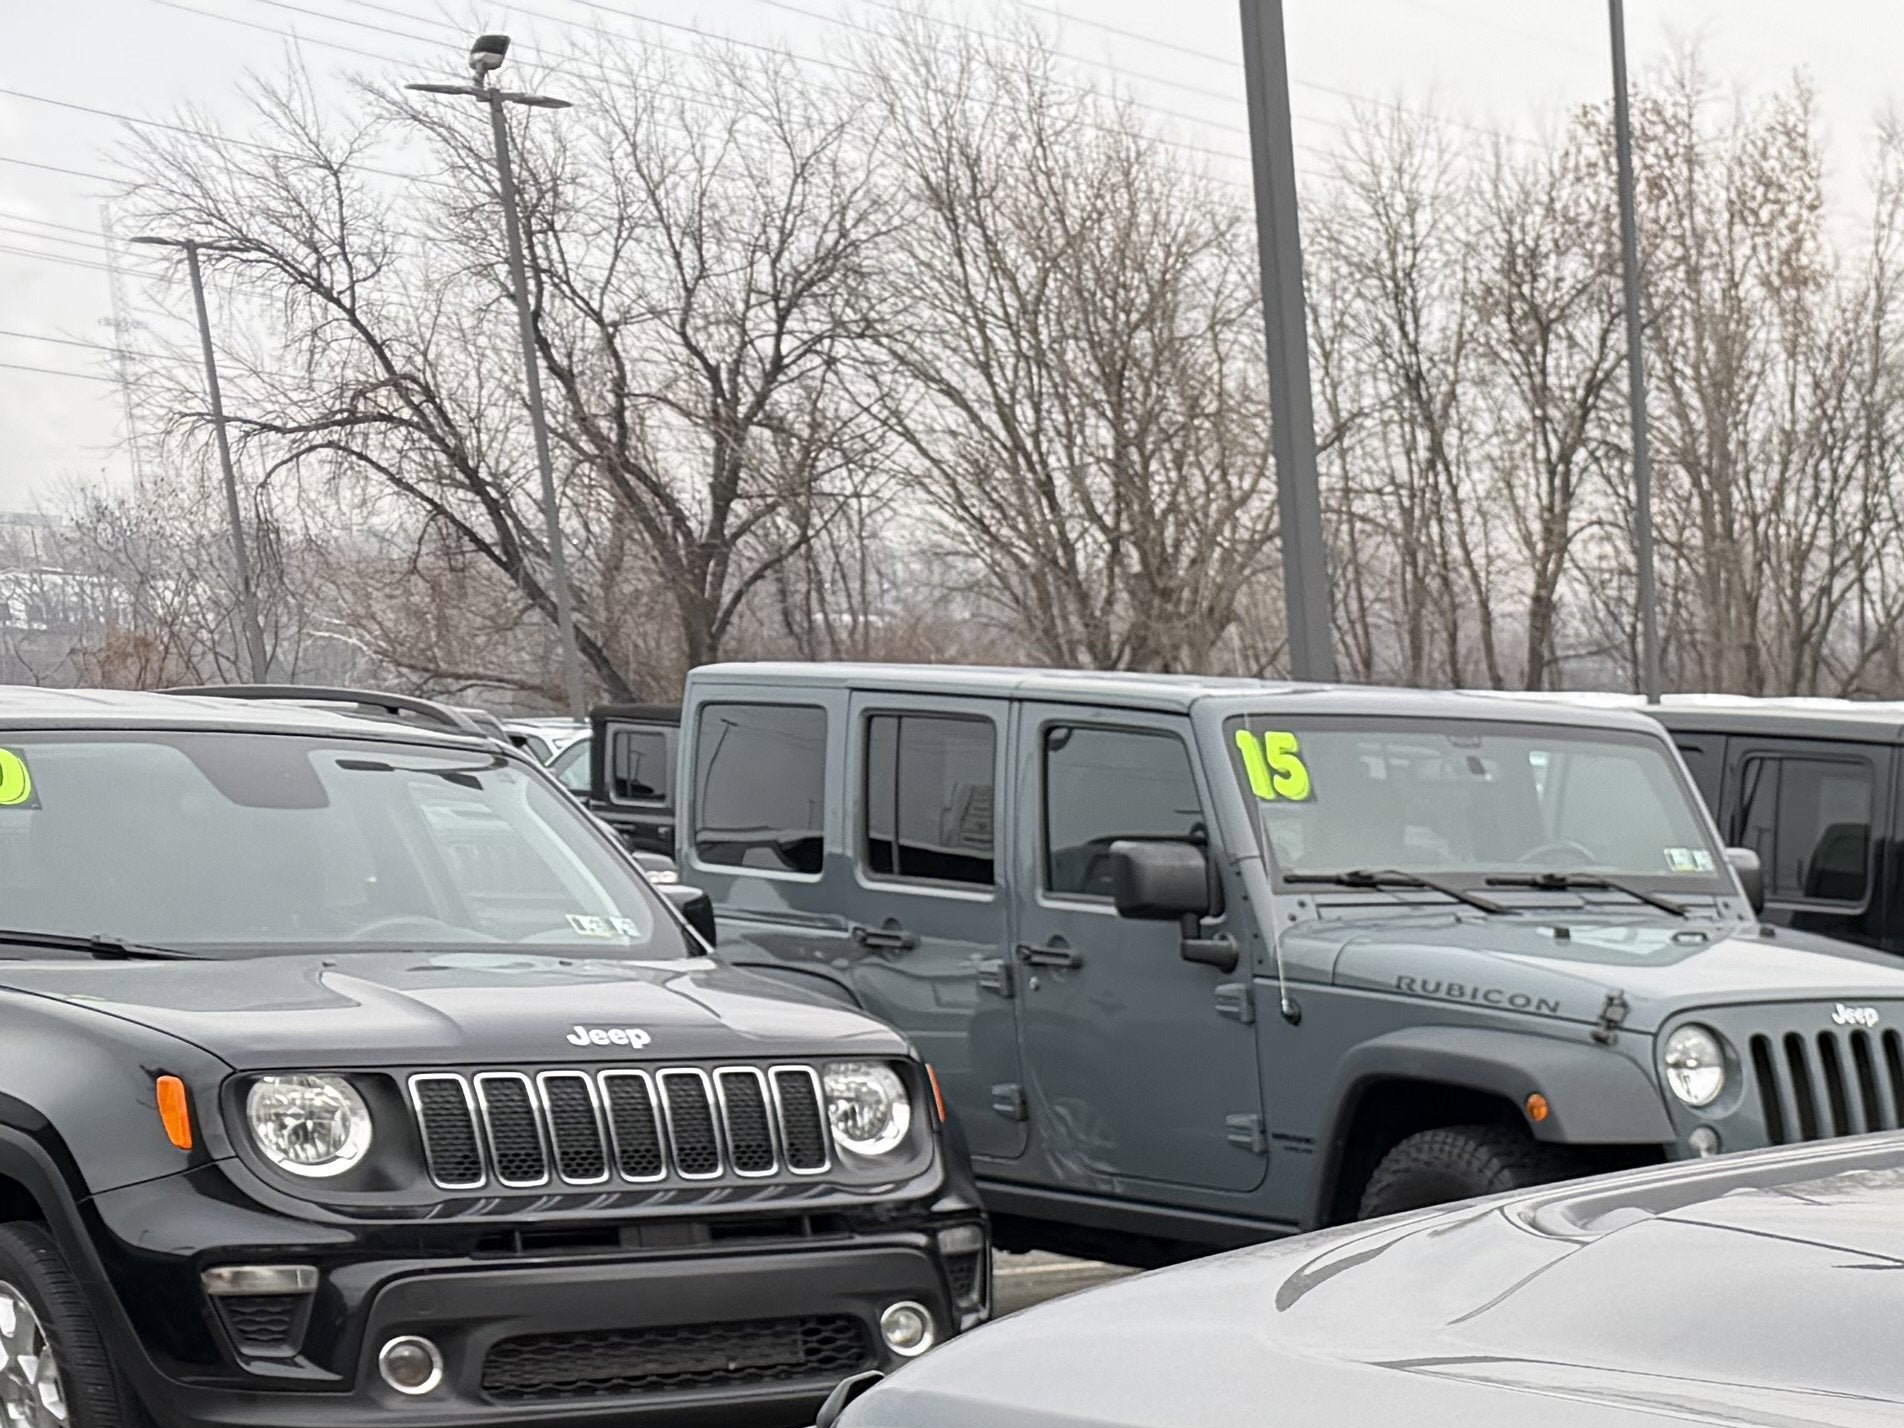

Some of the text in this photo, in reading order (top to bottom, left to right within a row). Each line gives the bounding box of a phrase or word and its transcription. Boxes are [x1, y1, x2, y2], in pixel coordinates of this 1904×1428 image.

[1235, 729, 1310, 801] 15
[1394, 974, 1561, 1014] RUBICON
[1831, 1002, 1880, 1028] Jeep
[566, 1025, 652, 1049] Jeep
